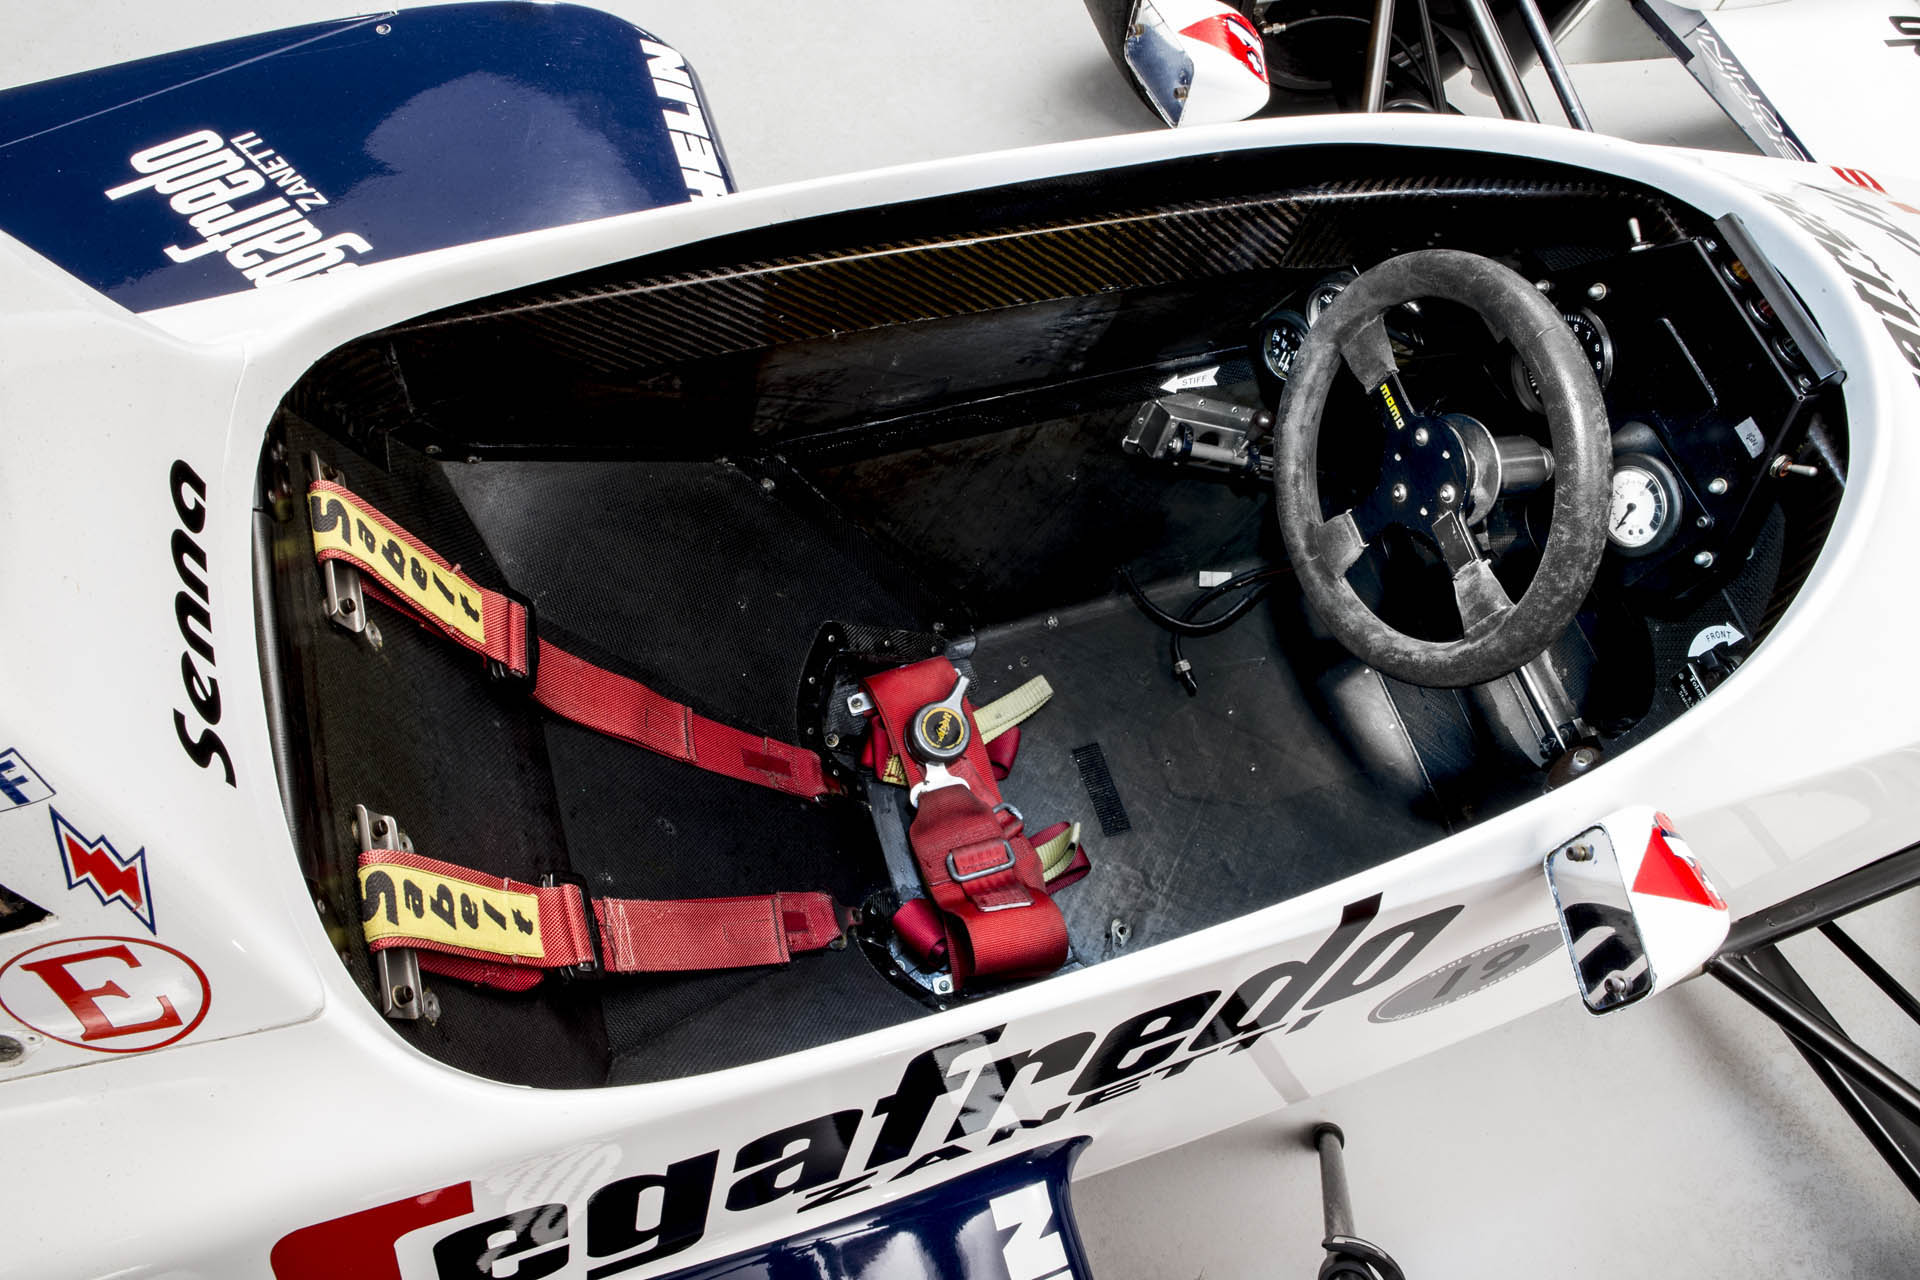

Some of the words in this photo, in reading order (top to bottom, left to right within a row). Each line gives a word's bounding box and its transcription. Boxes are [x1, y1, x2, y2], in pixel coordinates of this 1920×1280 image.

[230, 131, 328, 212] ZANETTI
[104, 130, 373, 288] gafredo
[1573, 323, 1579, 333] 6
[1585, 331, 1592, 341] 7
[1594, 343, 1600, 353] 8
[1182, 375, 1208, 387] STIFF
[1596, 361, 1602, 370] 9
[1380, 383, 1405, 430] momo
[311, 495, 480, 623] Sabelt
[170, 458, 237, 789] Senna
[1705, 630, 1732, 643] FRONT
[362, 870, 533, 936] Sabelt
[19, 944, 184, 1041] E
[1432, 944, 1530, 1000] 19
